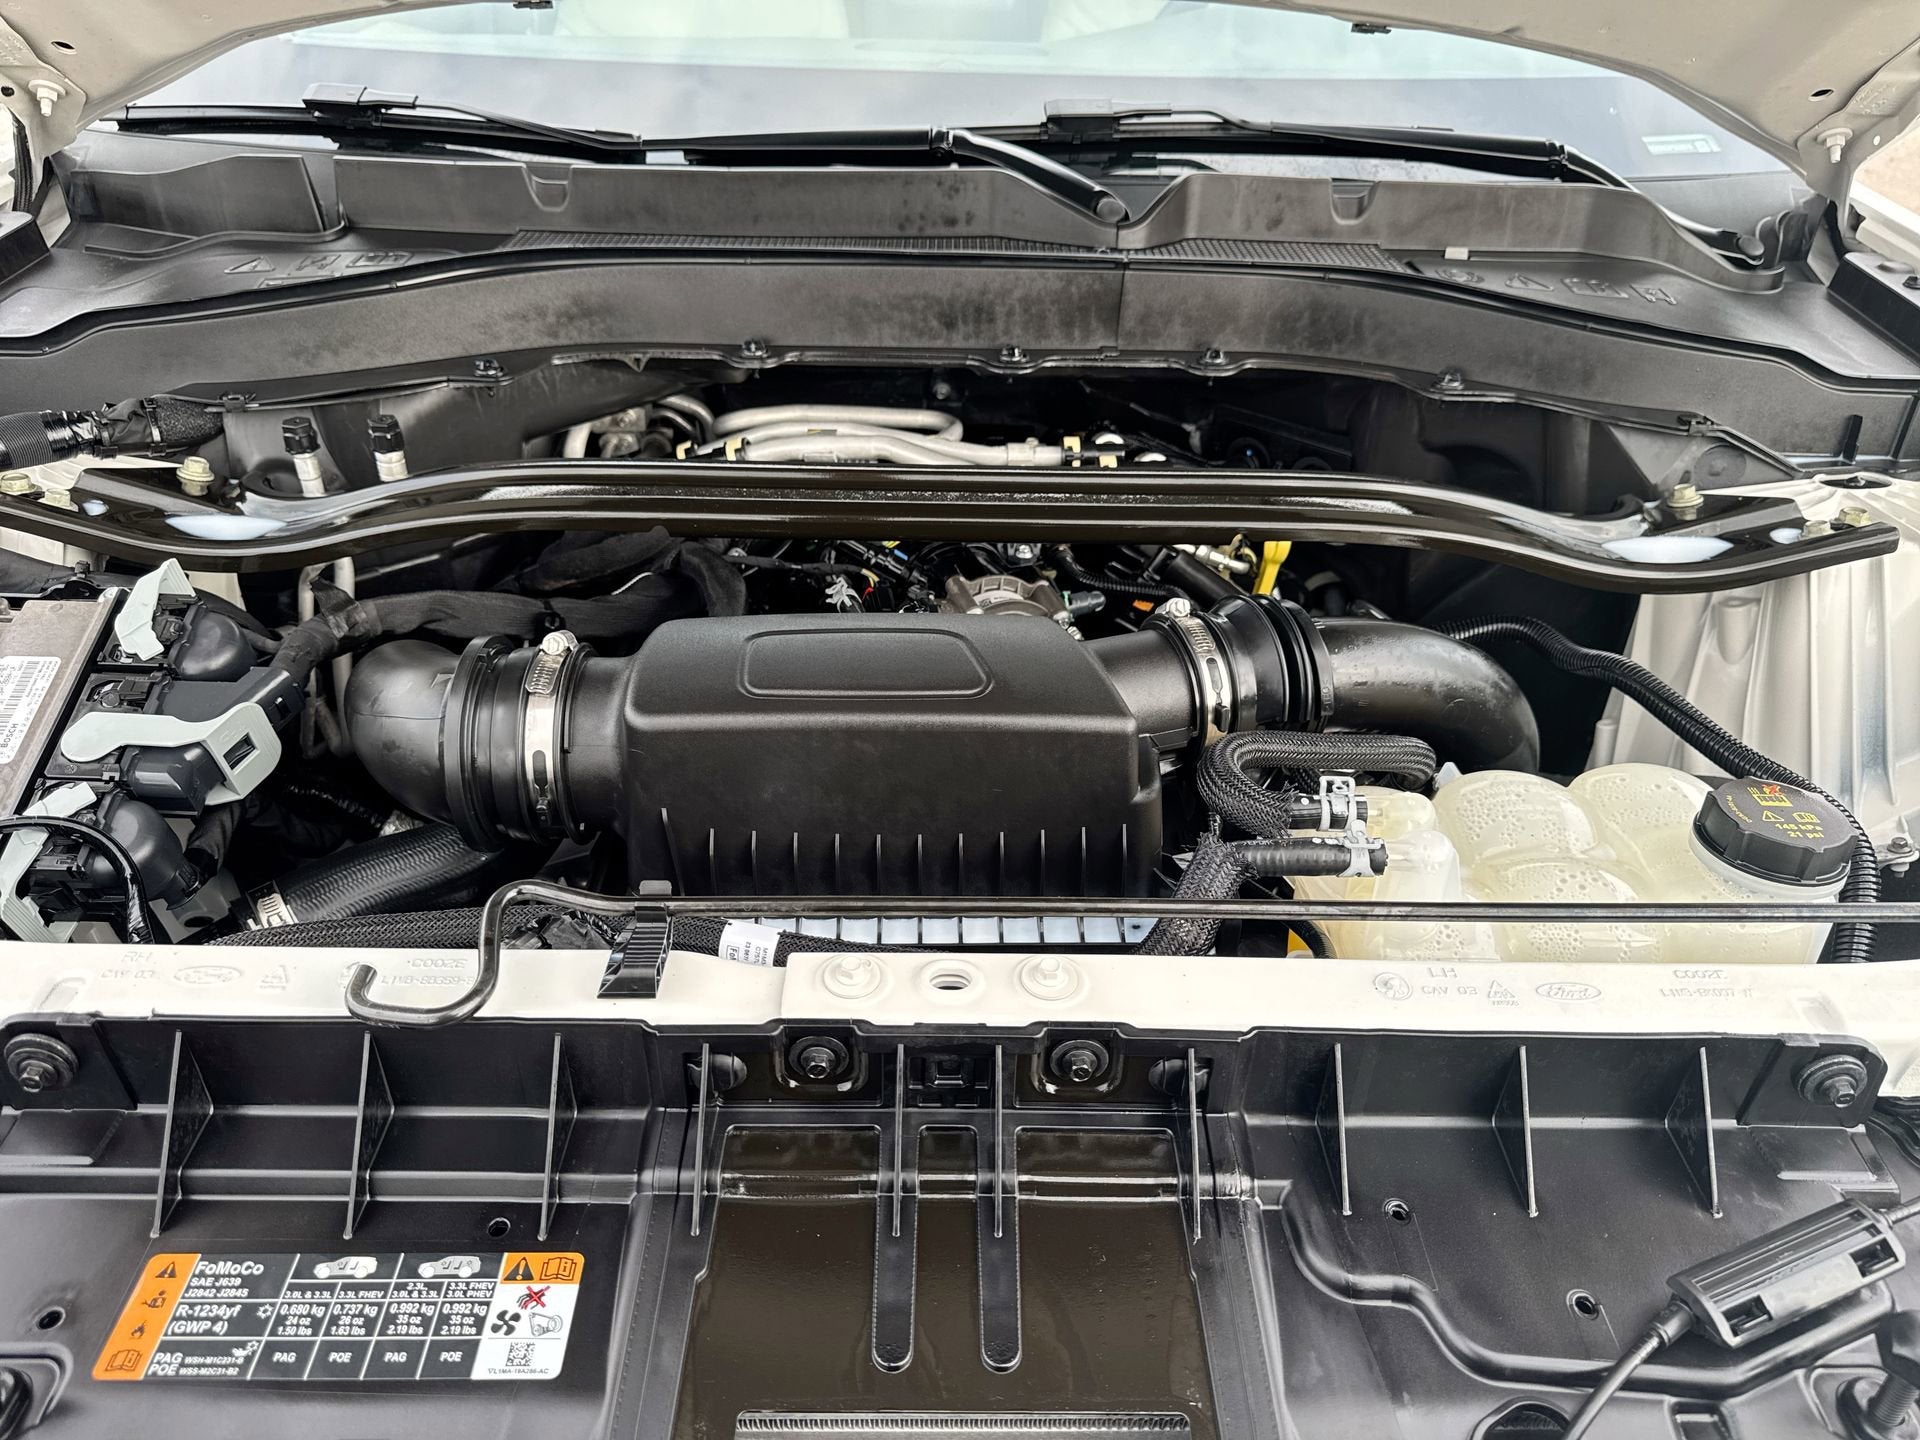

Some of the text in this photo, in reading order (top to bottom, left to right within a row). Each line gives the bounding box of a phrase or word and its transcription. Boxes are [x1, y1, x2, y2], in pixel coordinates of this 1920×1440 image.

[0, 723, 19, 748] BOSCH
[1787, 830, 1825, 839] 21 psi
[194, 1261, 265, 1276] FoMoCo
[189, 1277, 242, 1287] SAE J639
[406, 1282, 428, 1291] 2.3L,
[449, 1282, 495, 1290] 3.3L FHEV
[184, 1288, 250, 1298] J2842 J2845
[284, 1290, 332, 1299] 3.0L & 3.3L
[338, 1290, 385, 1299] 3.3L FHEV
[391, 1290, 439, 1299] 3.0L & 3.3L
[446, 1290, 493, 1298] 3.0L PHEV
[175, 1304, 242, 1320] R-1234yf
[280, 1304, 326, 1318] 0.680 kg
[333, 1304, 379, 1318] 0.737 kg
[389, 1303, 435, 1317] 0.992 kg
[442, 1303, 488, 1317] 0.992 kg
[285, 1316, 312, 1326] 24 oz
[338, 1315, 365, 1325] 26 oz
[396, 1314, 422, 1324] 35 oz
[449, 1315, 475, 1325] 35 oz
[167, 1321, 228, 1336] (GWP 4)
[277, 1326, 313, 1336] 1.50 lbs
[330, 1326, 366, 1336] 1.63 lbs
[386, 1325, 424, 1335] 2.19 lbs
[440, 1325, 477, 1335] 2.19 lbs
[152, 1352, 184, 1364] PAG
[272, 1352, 297, 1363] PAG
[328, 1352, 353, 1363] POE
[384, 1351, 408, 1363] PAG
[439, 1351, 463, 1362] POE
[147, 1363, 180, 1376] POE
